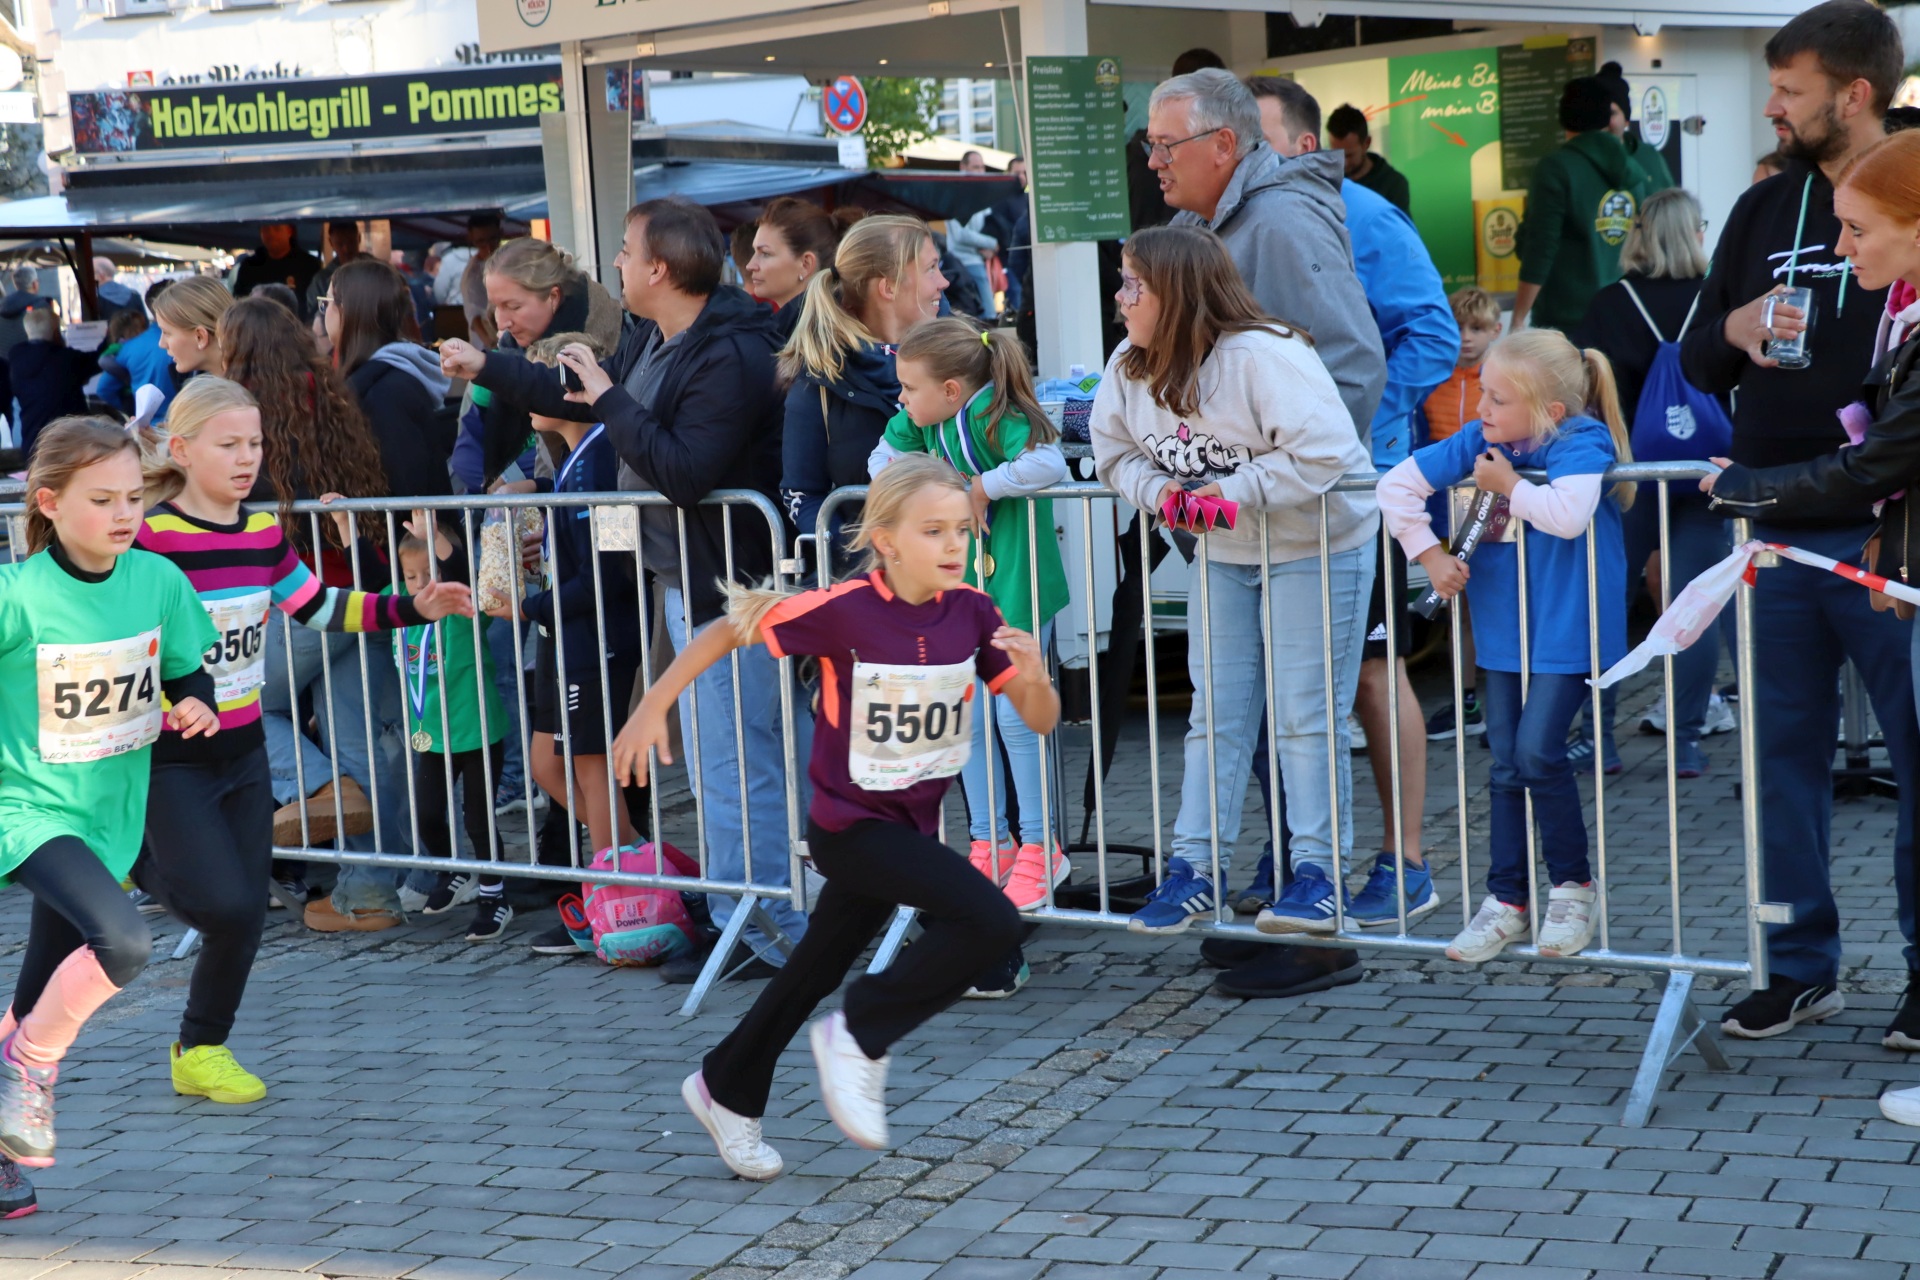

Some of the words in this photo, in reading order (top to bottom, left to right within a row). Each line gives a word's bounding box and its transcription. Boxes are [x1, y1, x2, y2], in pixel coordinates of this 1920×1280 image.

[1032, 65, 1063, 75] Preisliste
[1401, 69, 1462, 94] Meine
[151, 86, 371, 139] Holzkohlegrill
[409, 81, 560, 124] Pommes
[1421, 100, 1473, 119] mein
[1461, 520, 1482, 552] NEUE
[203, 621, 263, 665] 5505
[1367, 633, 1388, 641] adida
[54, 665, 154, 720] 5274
[866, 697, 964, 743] 5501
[84, 747, 112, 758] VOSS
[114, 741, 135, 753] BEW
[614, 900, 649, 920] PUP
